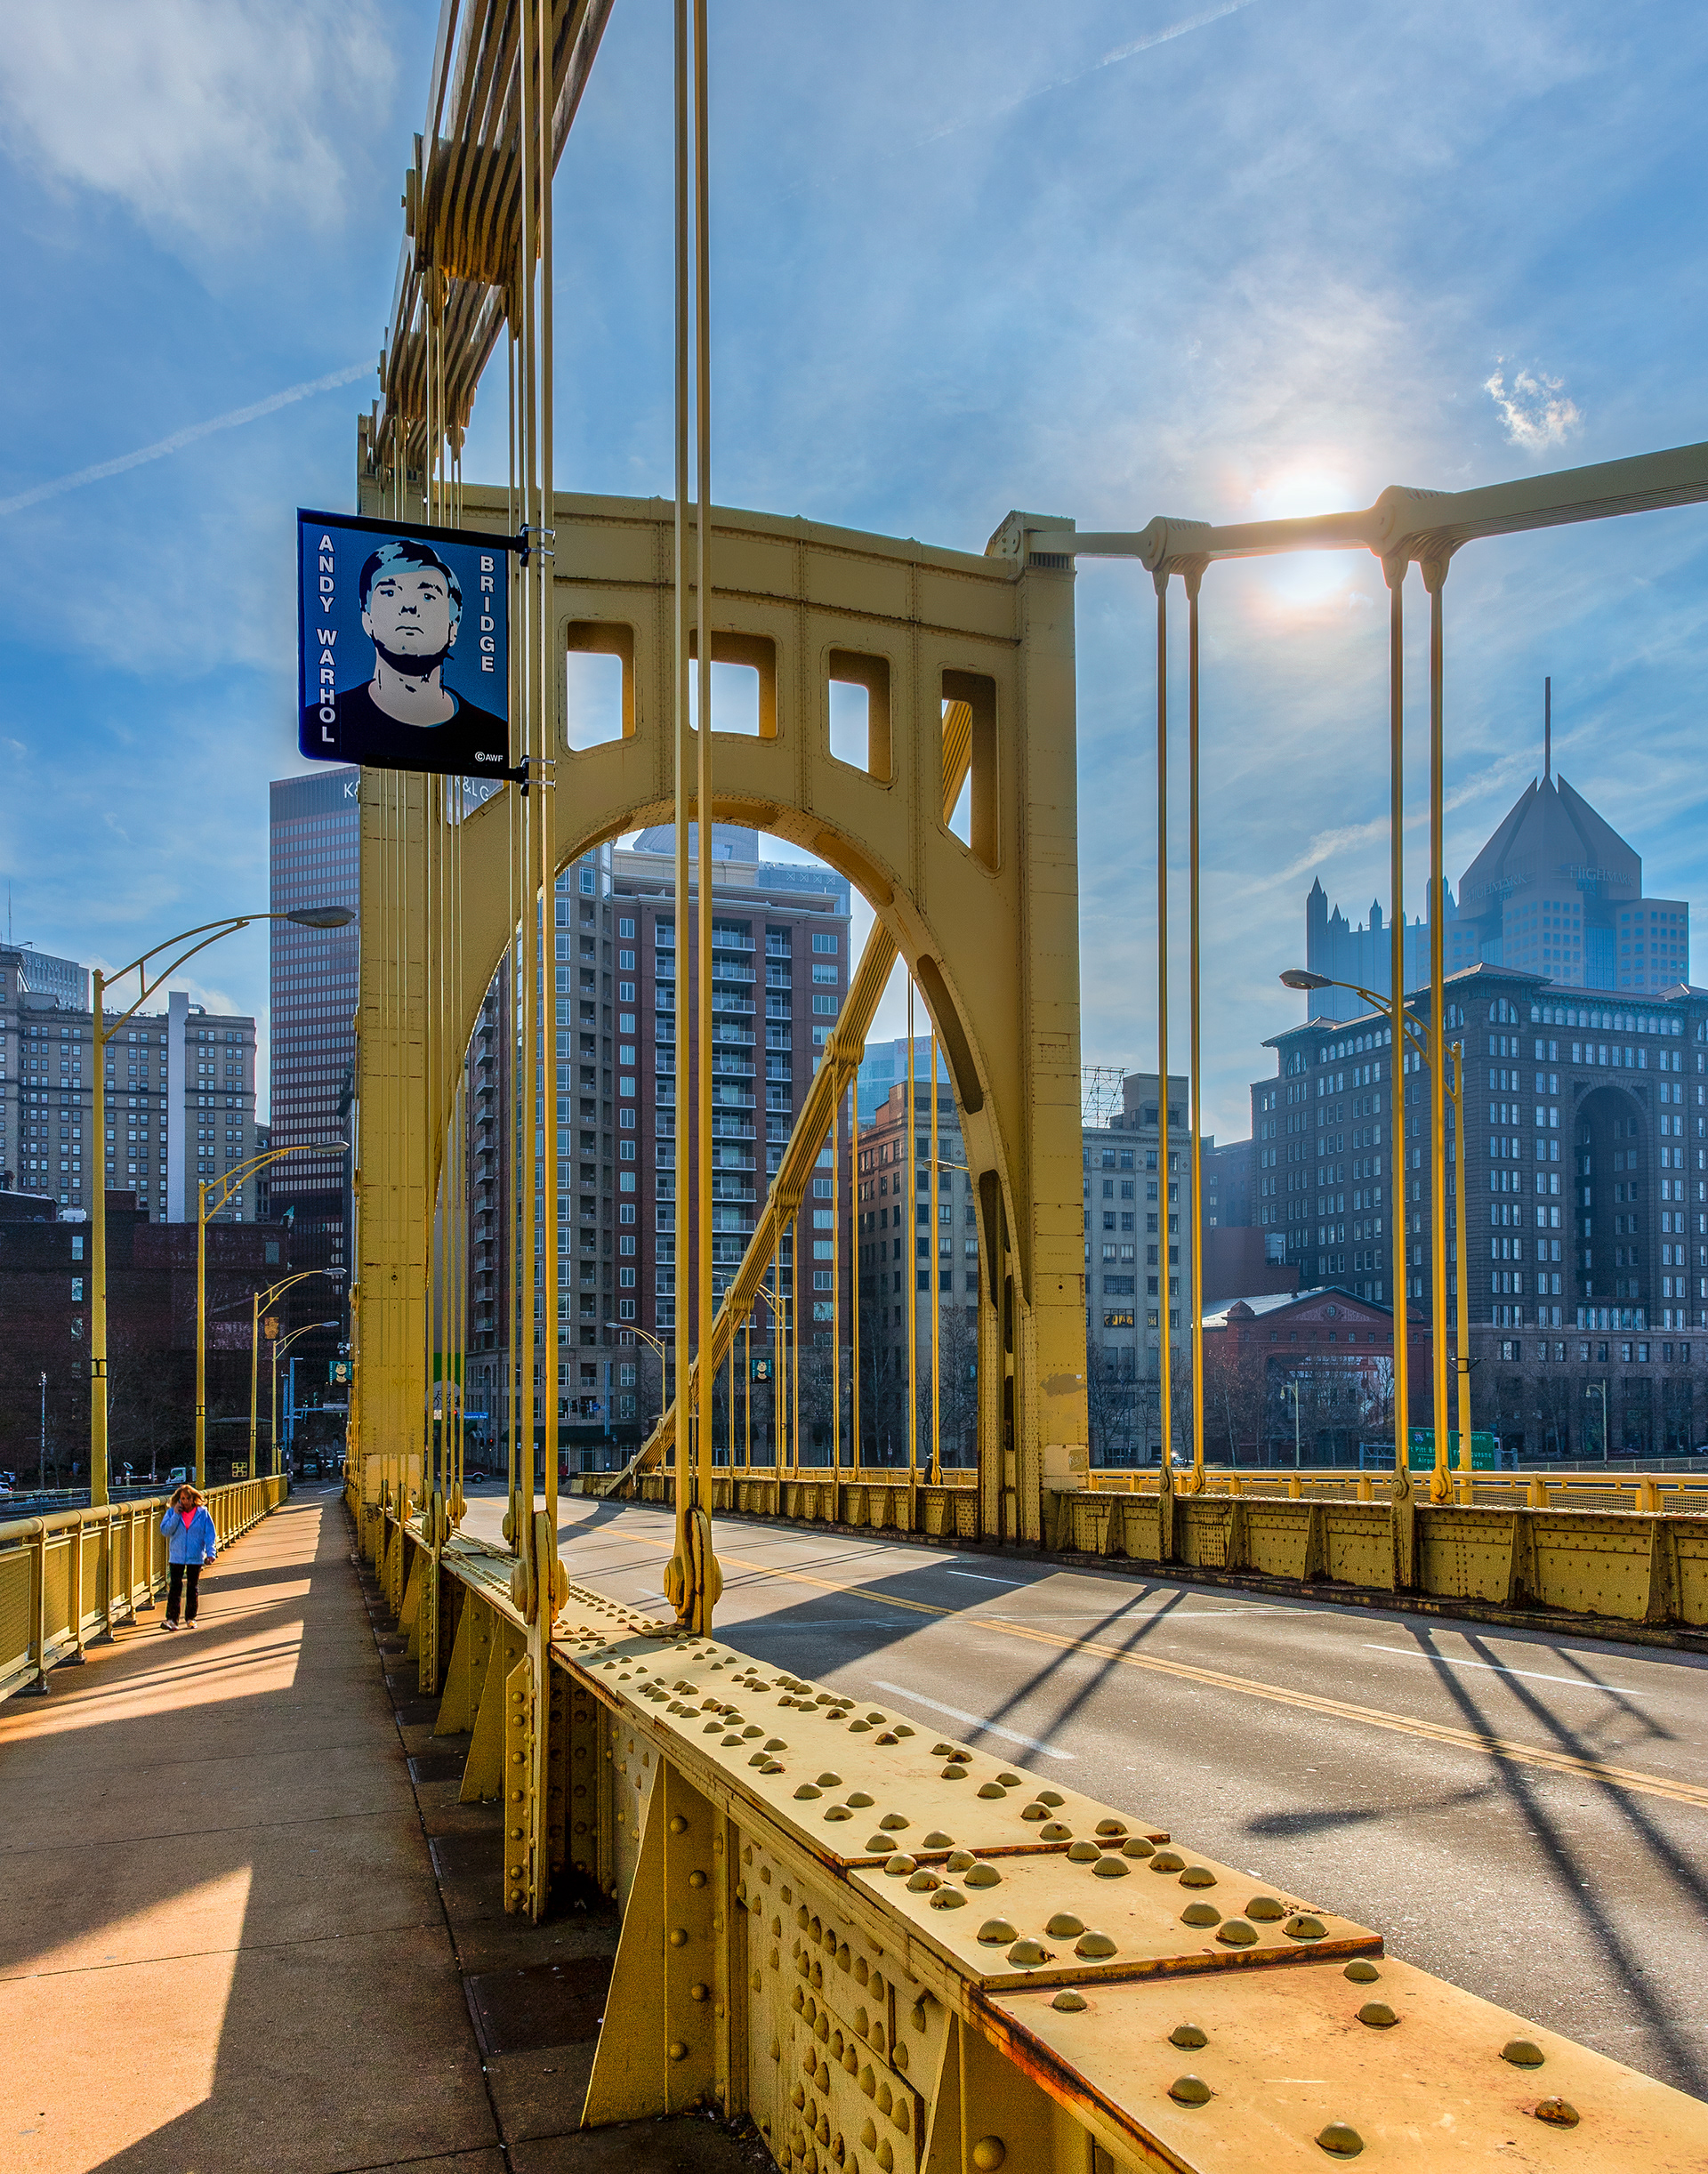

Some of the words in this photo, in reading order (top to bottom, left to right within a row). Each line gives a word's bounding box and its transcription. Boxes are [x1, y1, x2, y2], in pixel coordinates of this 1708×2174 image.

[318, 535, 334, 613] ANDY
[480, 556, 494, 672] BRIDGE
[316, 628, 337, 743] WARHOL
[898, 1039, 926, 1054] Red
